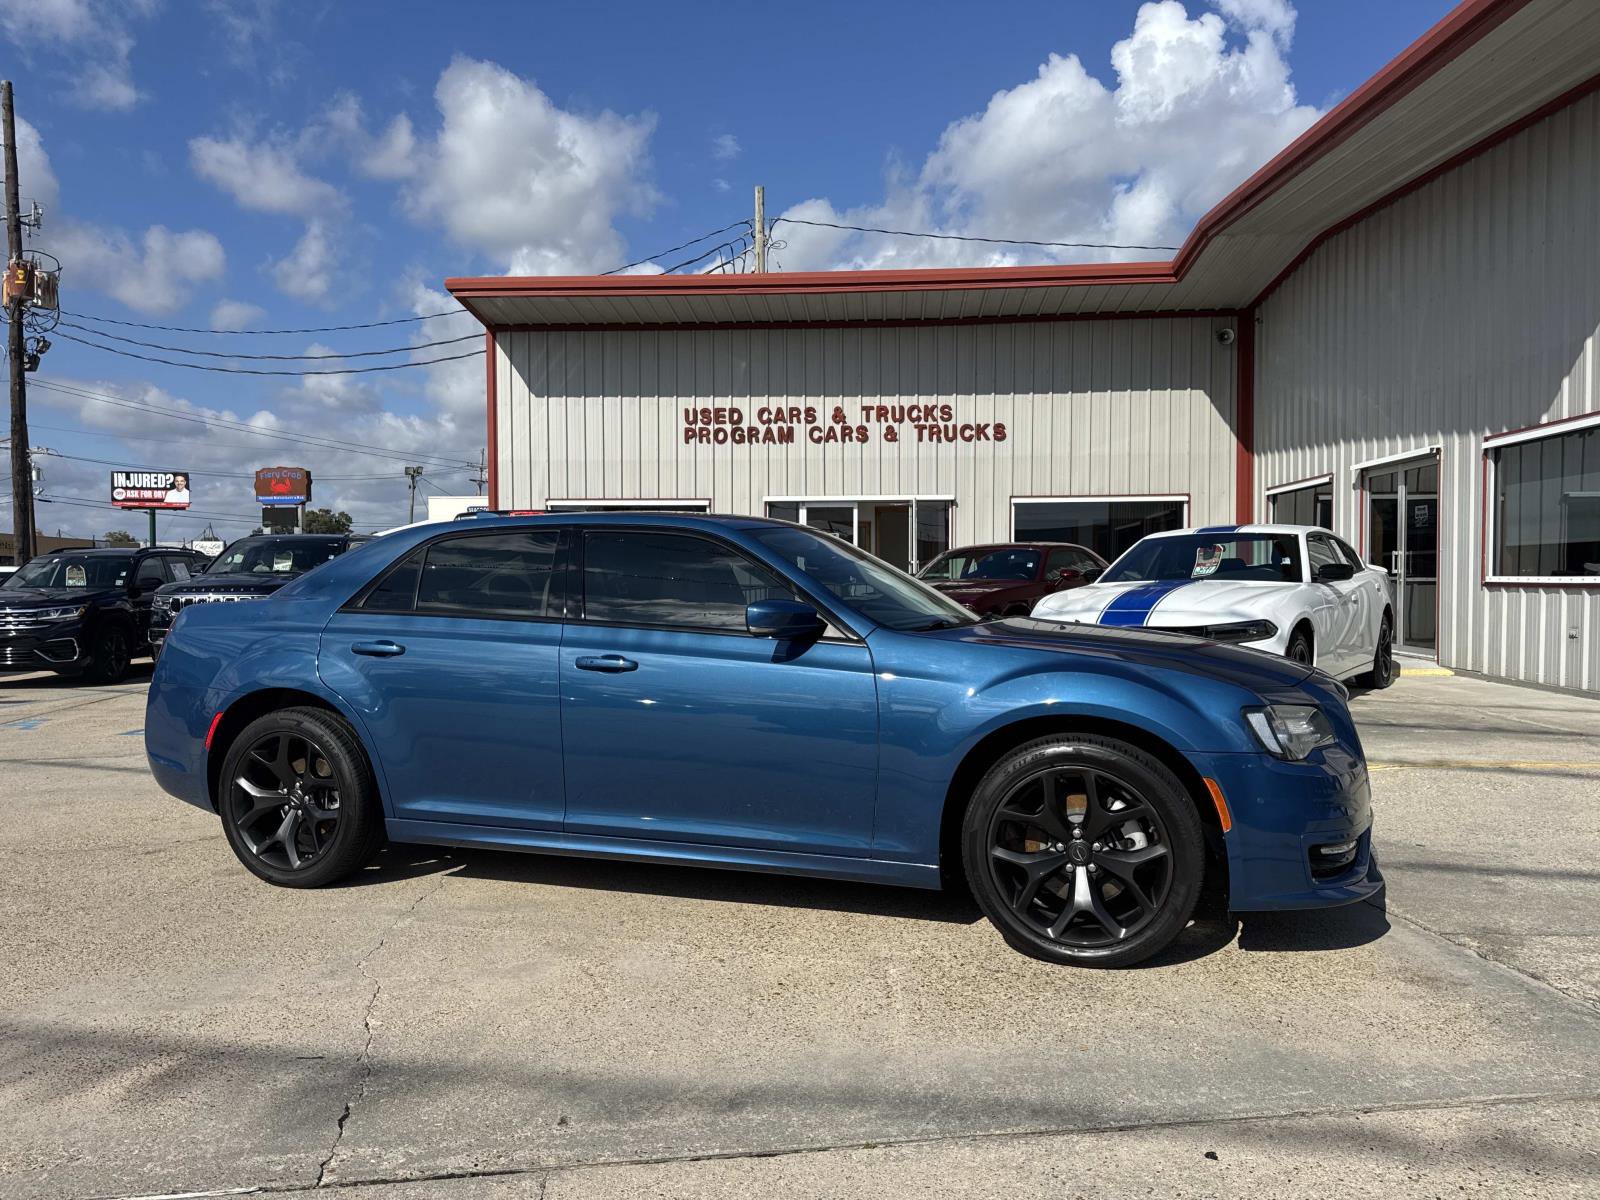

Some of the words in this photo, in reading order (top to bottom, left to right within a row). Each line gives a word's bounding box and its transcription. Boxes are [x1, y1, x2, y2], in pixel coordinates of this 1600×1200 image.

[684, 407, 743, 426] USED
[757, 406, 817, 425] CARS
[831, 406, 847, 425] &
[861, 404, 953, 424] TRUCKS
[684, 426, 795, 445] PROGRAM
[808, 425, 869, 444] CARS
[883, 424, 899, 443] &
[914, 422, 1007, 443] TRUCKS
[113, 472, 175, 489] INJURED?
[126, 490, 139, 498] ASK
[140, 490, 152, 499] FOR
